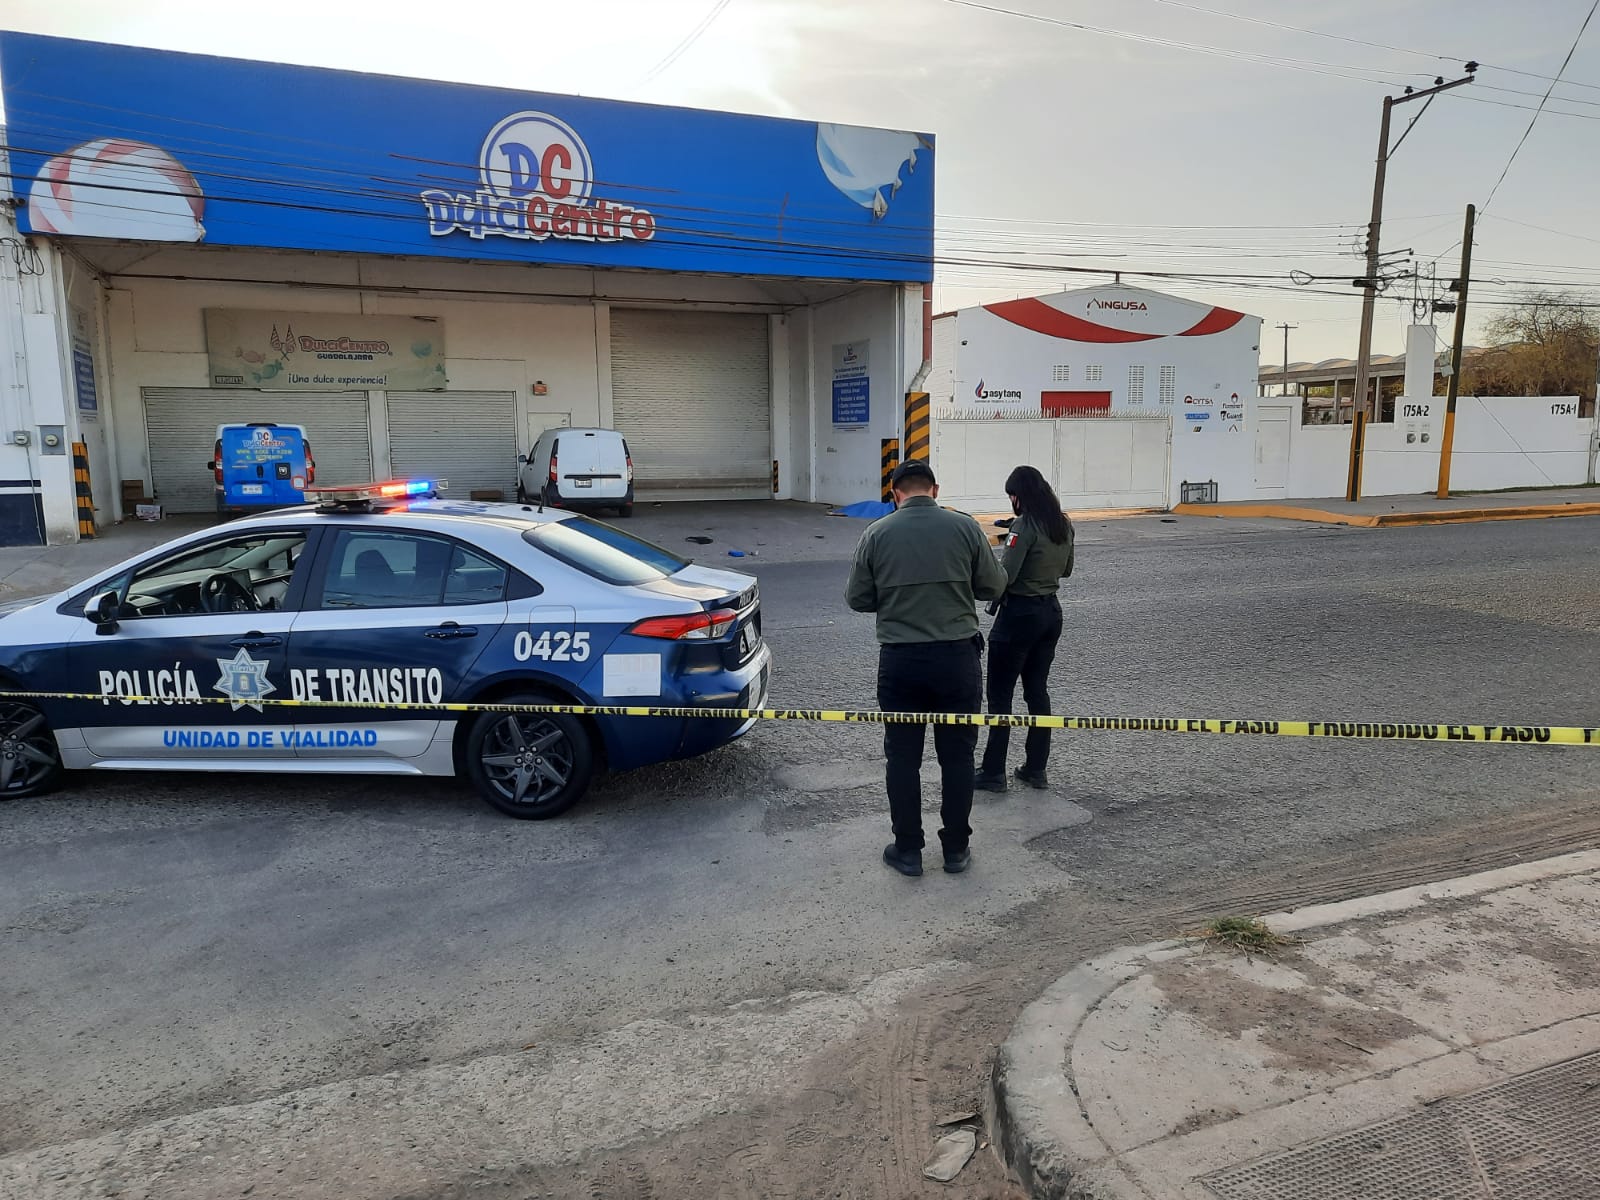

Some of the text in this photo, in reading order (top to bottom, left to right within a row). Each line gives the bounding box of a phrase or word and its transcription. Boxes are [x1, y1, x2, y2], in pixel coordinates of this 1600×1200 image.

[499, 142, 572, 199] DC
[288, 373, 387, 386] ¡Una dulce experiencia!
[1403, 404, 1430, 417] 175A-2
[1551, 403, 1577, 416] 175A-1
[514, 631, 591, 662] 0425
[98, 661, 443, 706] POLICÍA DE TRANSITO
[163, 729, 378, 748] UNIDAD DE VIALIDAD
